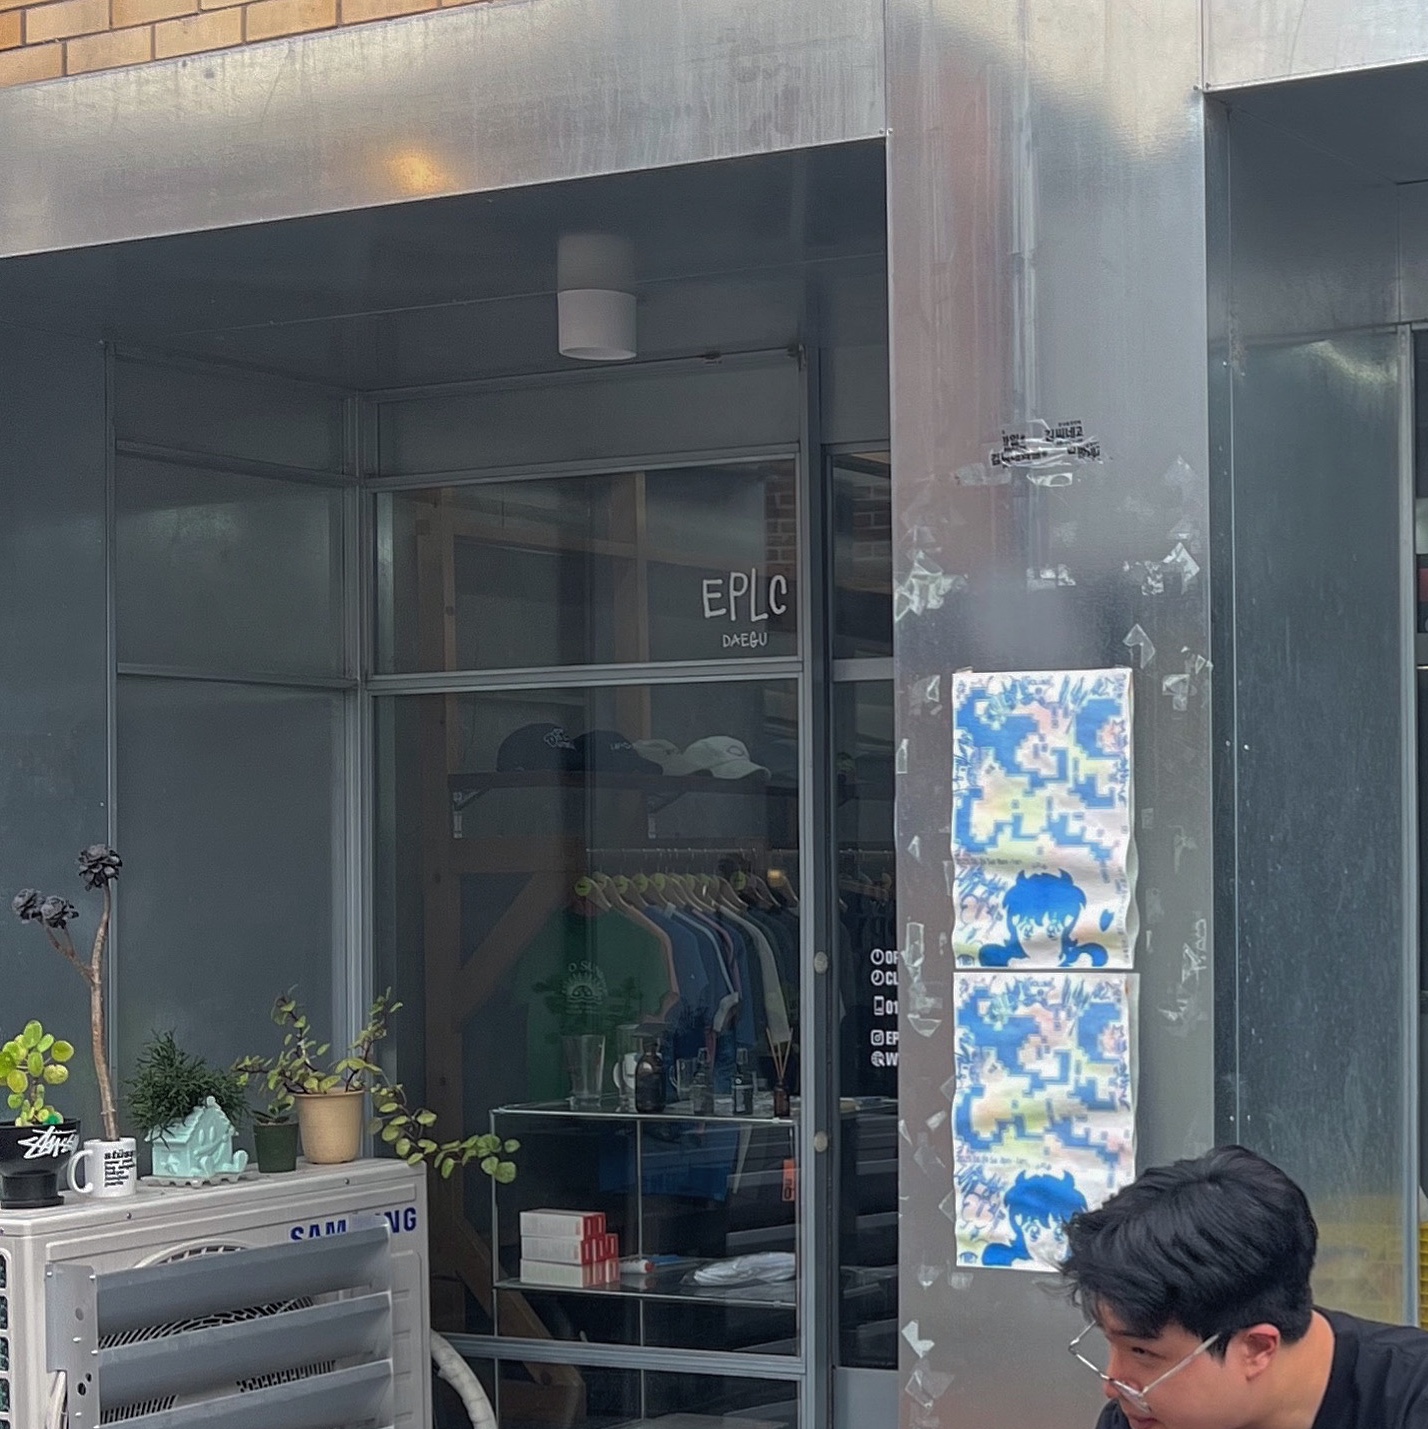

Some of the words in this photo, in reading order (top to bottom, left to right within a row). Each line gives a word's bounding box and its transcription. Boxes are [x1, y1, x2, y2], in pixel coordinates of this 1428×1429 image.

[703, 568, 787, 621] EPLC
[723, 631, 768, 648] DAEGU
[290, 1206, 418, 1242] SAMNG
